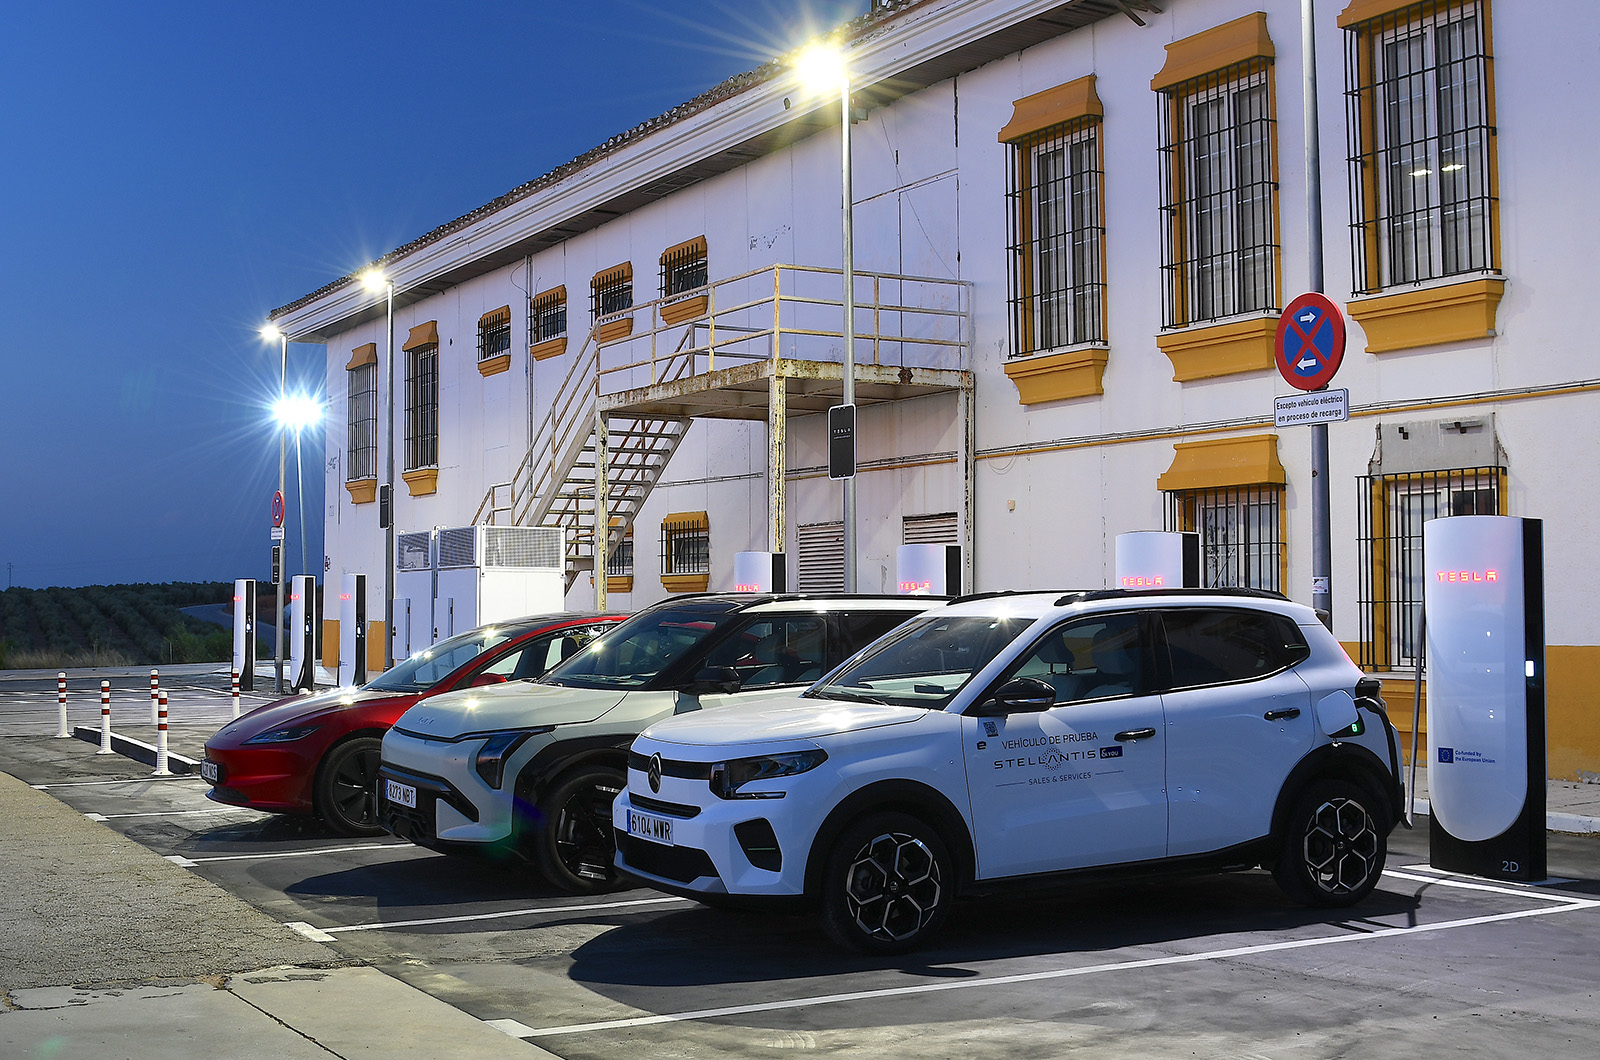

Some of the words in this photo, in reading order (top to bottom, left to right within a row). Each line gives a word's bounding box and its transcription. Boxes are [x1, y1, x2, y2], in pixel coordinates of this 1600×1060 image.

[1276, 402, 1297, 410] Excepto
[1320, 395, 1343, 404] eléctrico
[1286, 412, 1310, 422] proceso
[1311, 410, 1318, 418] de
[1319, 409, 1342, 418] recarga
[1121, 576, 1164, 587] TESLA
[1436, 570, 1498, 583] TESLA
[899, 581, 931, 591] TESLA
[1001, 737, 1047, 749] VEHÍCULO
[1048, 735, 1061, 745] DE
[1063, 732, 1099, 743] PRUEBA
[993, 749, 1097, 770] STELLANTIS
[1028, 776, 1051, 785] SALES
[1052, 775, 1058, 783] &
[1059, 772, 1092, 782] SERVICES
[631, 814, 651, 836] 6104
[1502, 860, 1519, 872] 2D
